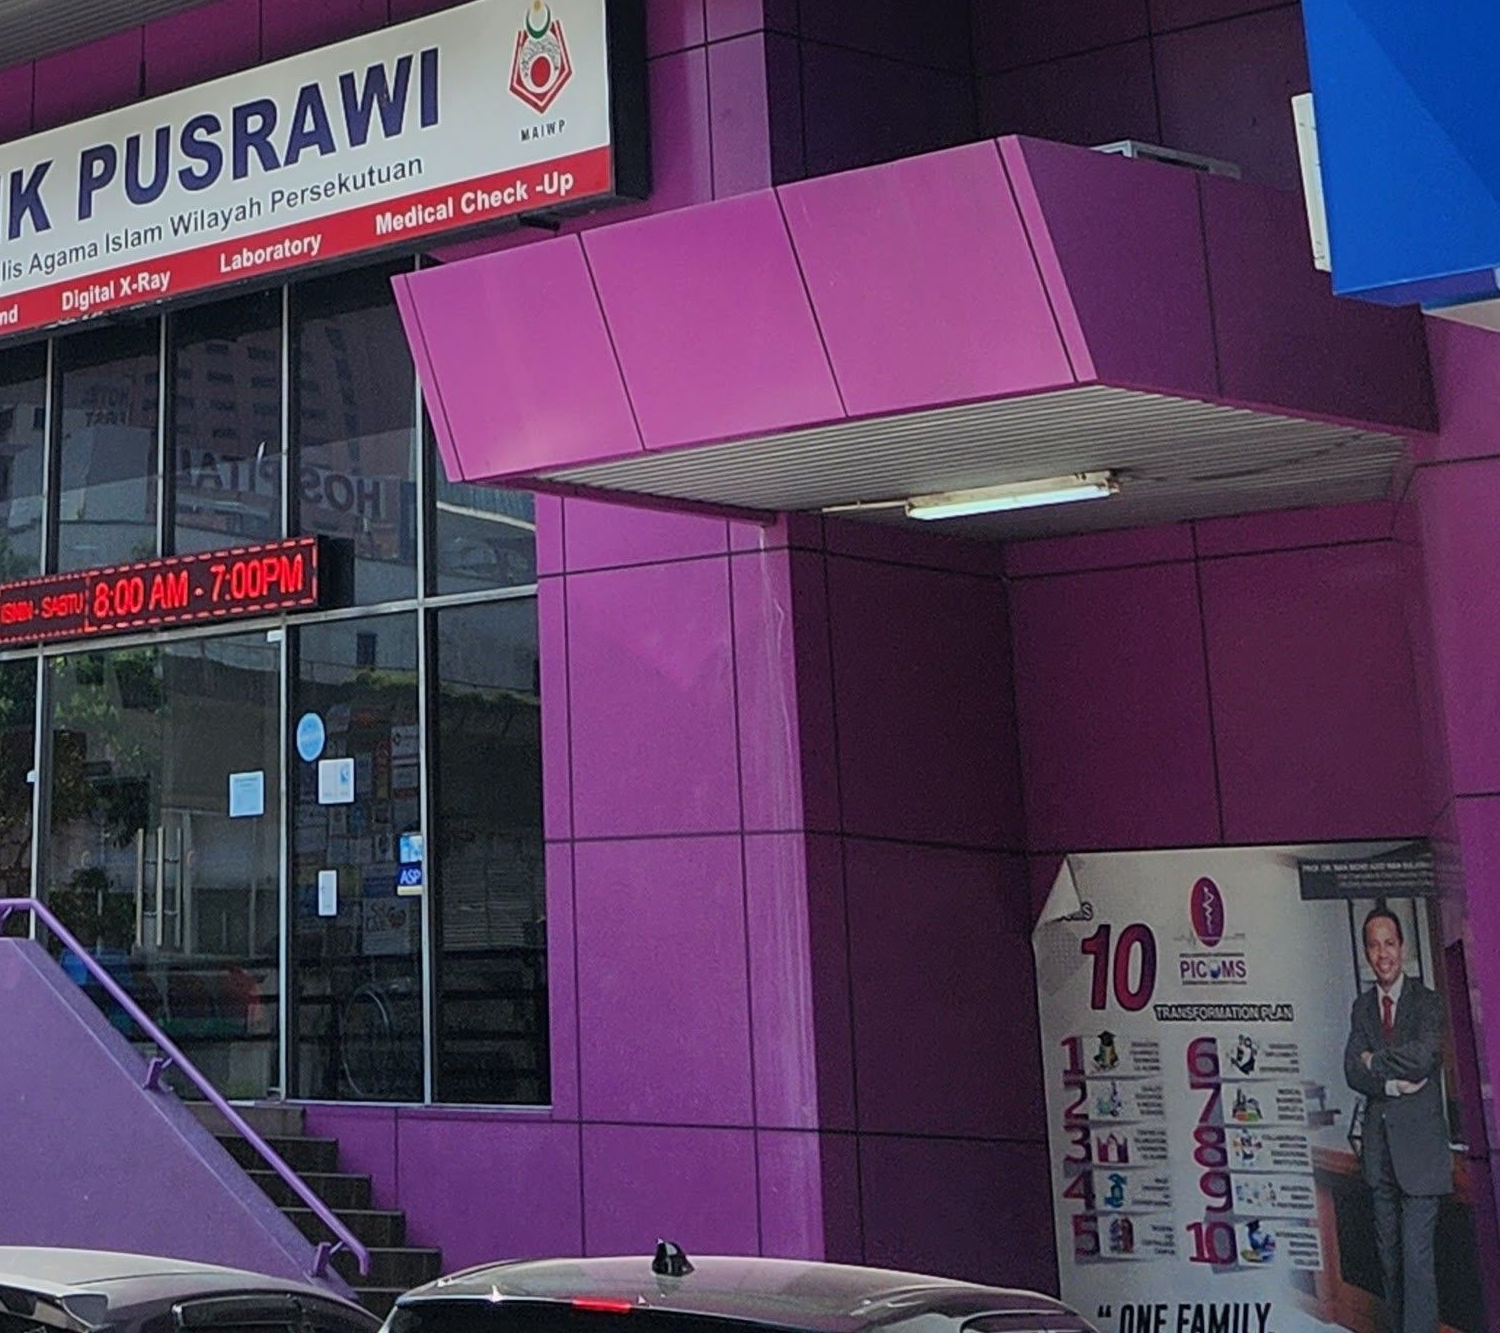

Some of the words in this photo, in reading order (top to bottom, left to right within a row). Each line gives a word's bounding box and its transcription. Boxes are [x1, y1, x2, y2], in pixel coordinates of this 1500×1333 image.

[78, 47, 438, 221] PUSRAWI
[520, 119, 566, 142] MAIWP
[28, 242, 99, 274] Agama
[105, 225, 162, 254] Islam
[170, 198, 261, 237] Wilayah
[271, 157, 423, 213] Persekutuan
[61, 282, 115, 313] Digital
[120, 270, 171, 296] X-Ray
[220, 233, 322, 274] Laboratory
[376, 196, 454, 235] Medical
[461, 180, 529, 214] Check
[535, 170, 575, 198] -Up
[41, 592, 84, 618] SABTU
[93, 574, 144, 618] 8:00
[149, 569, 189, 610] AM
[210, 552, 303, 603] 7:00PM
[1081, 923, 1157, 1012] 10
[1154, 1004, 1260, 1021] TRANSFORMATION
[1260, 1004, 1293, 1021] PLAN
[1187, 1037, 1220, 1078] 6
[1064, 1080, 1089, 1120] 2
[1190, 1082, 1221, 1124] 7
[1064, 1124, 1092, 1164] 3
[1193, 1125, 1228, 1168] 8
[1063, 1171, 1096, 1209] 4
[1200, 1171, 1233, 1213] 9
[1072, 1215, 1100, 1257] 5
[1186, 1221, 1237, 1264] 10
[1119, 1304, 1169, 1333] ONE
[1177, 1302, 1275, 1333] FAMILY
